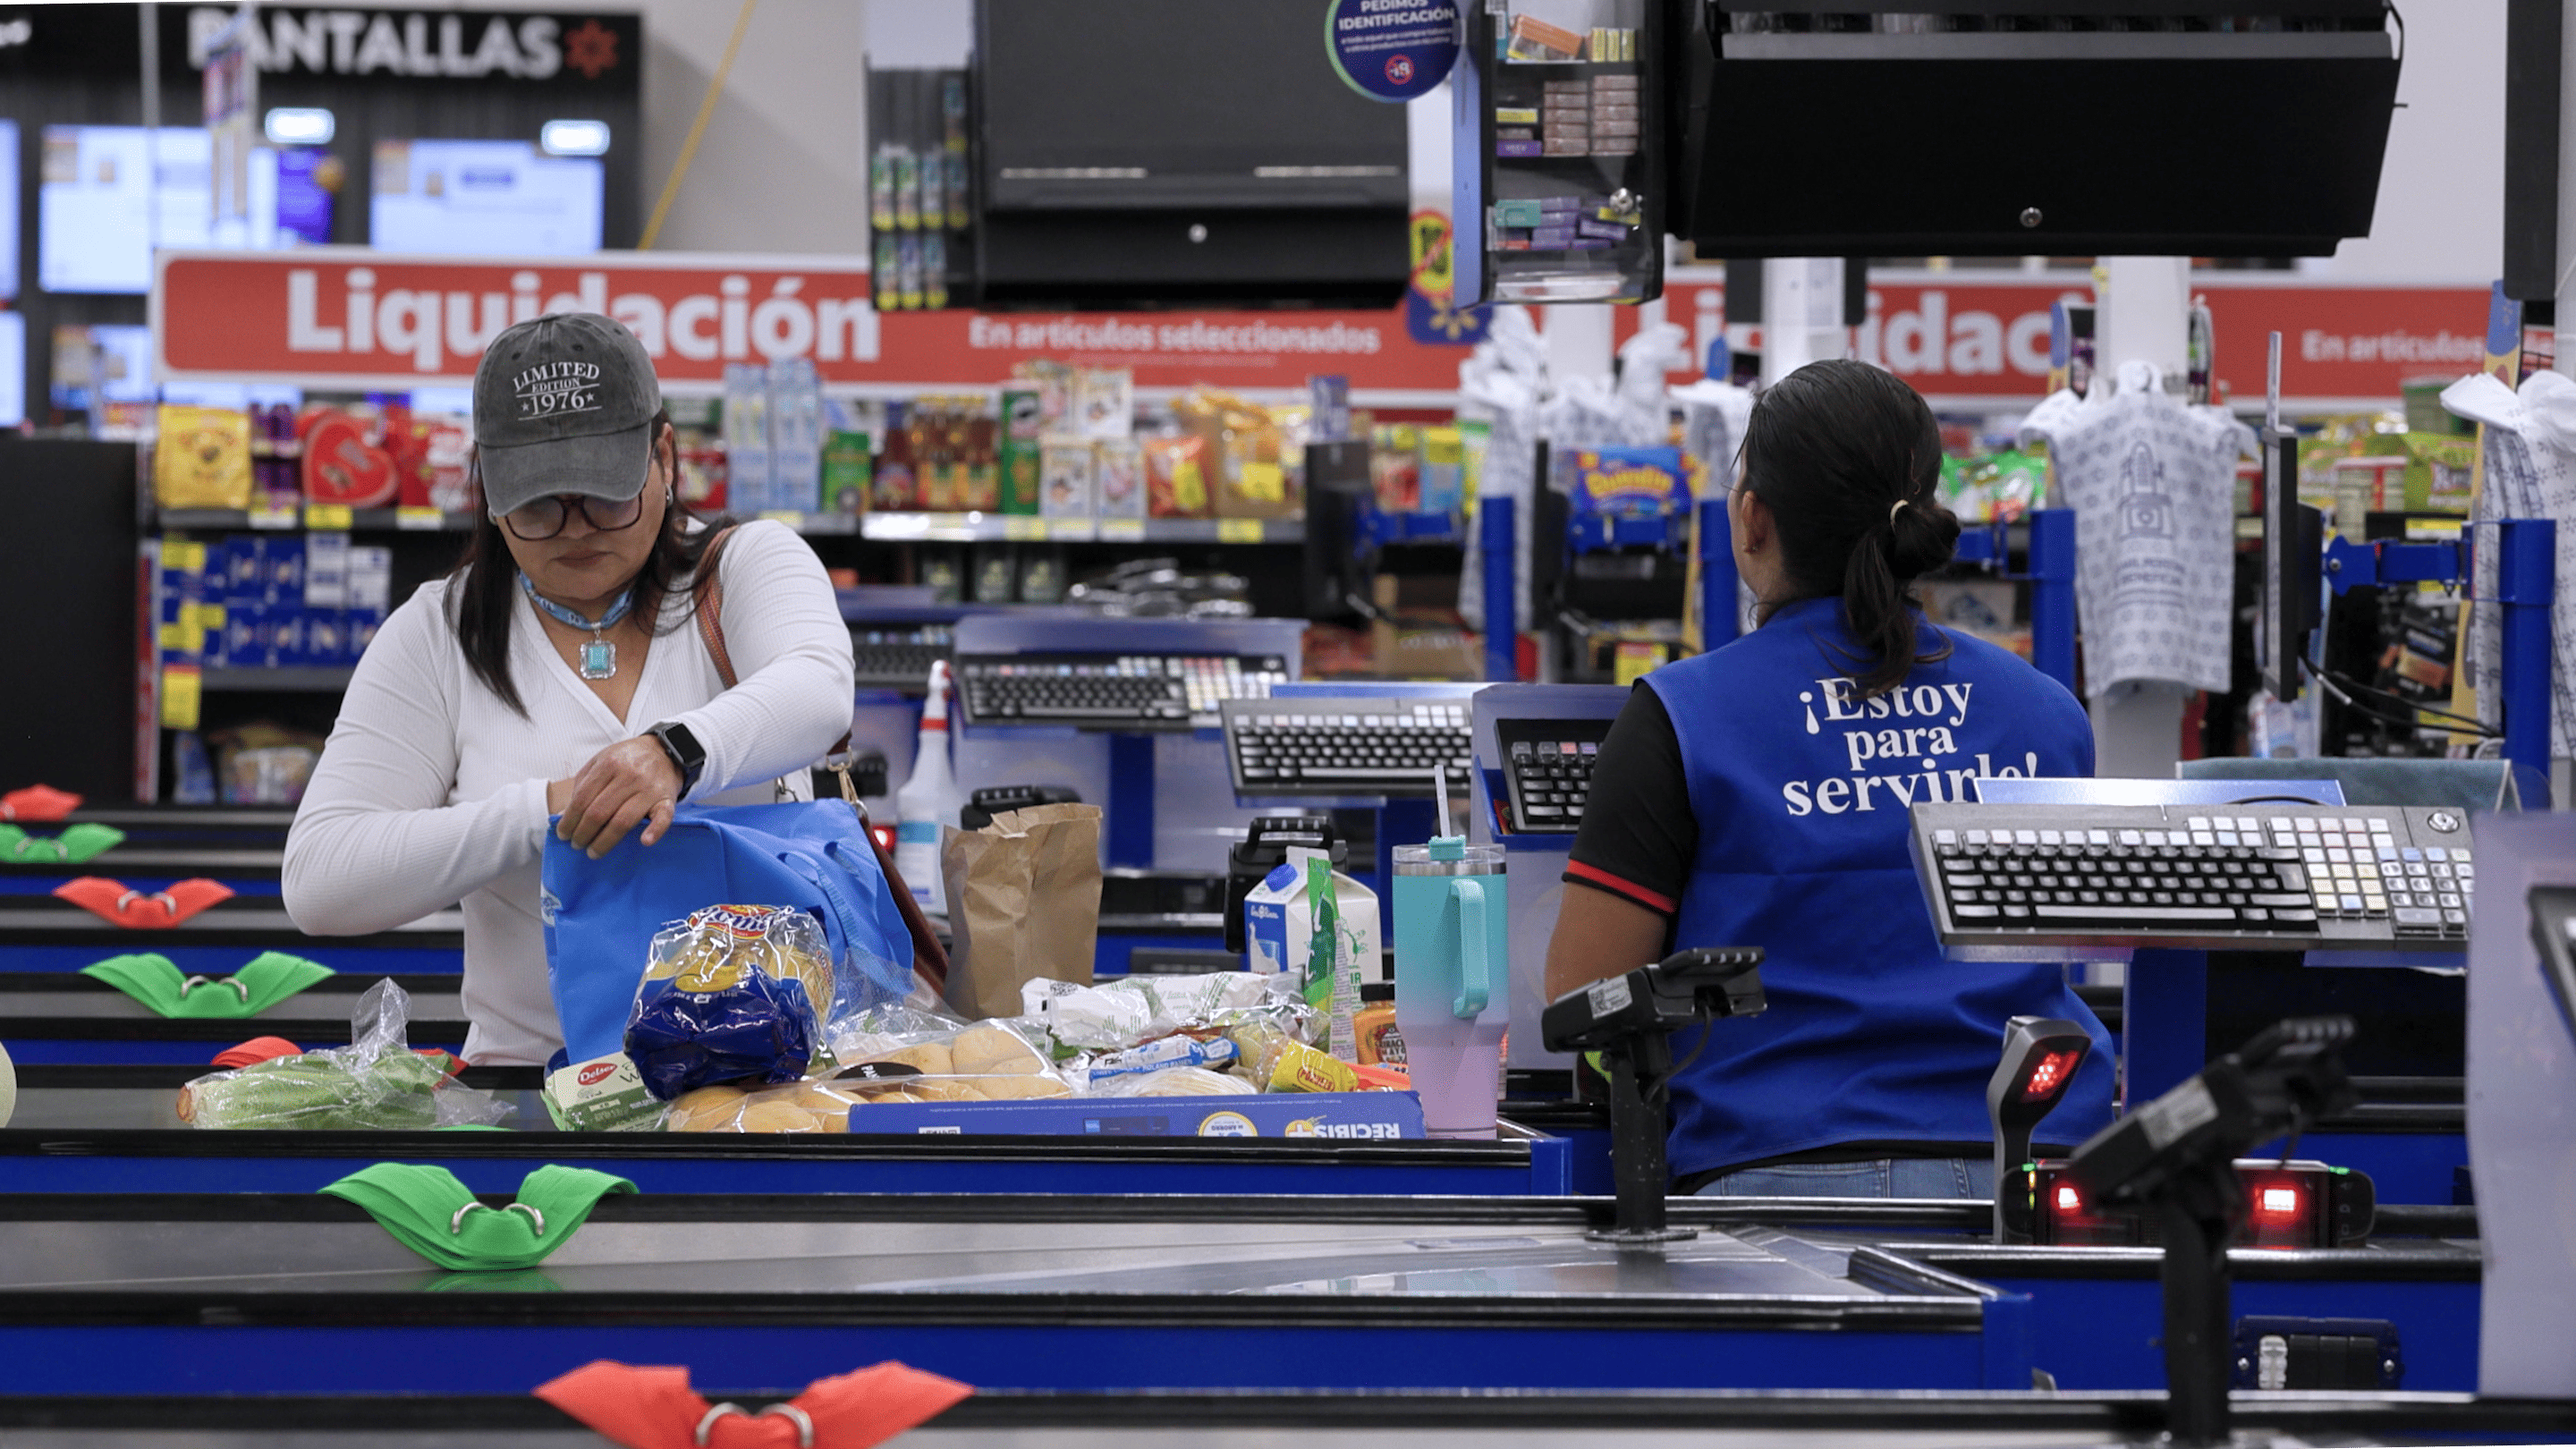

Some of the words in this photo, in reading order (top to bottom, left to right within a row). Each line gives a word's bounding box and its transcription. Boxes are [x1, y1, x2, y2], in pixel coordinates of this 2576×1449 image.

[1338, 7, 1454, 30] IDENTIFICACIÓN
[969, 316, 1013, 348] En
[1158, 318, 1381, 353] seleccionados
[513, 361, 600, 393] LIMITED
[531, 377, 580, 394] EDITION
[530, 388, 585, 415] 1976
[1799, 677, 1973, 734] ¡Estoy
[1843, 725, 1958, 771] para
